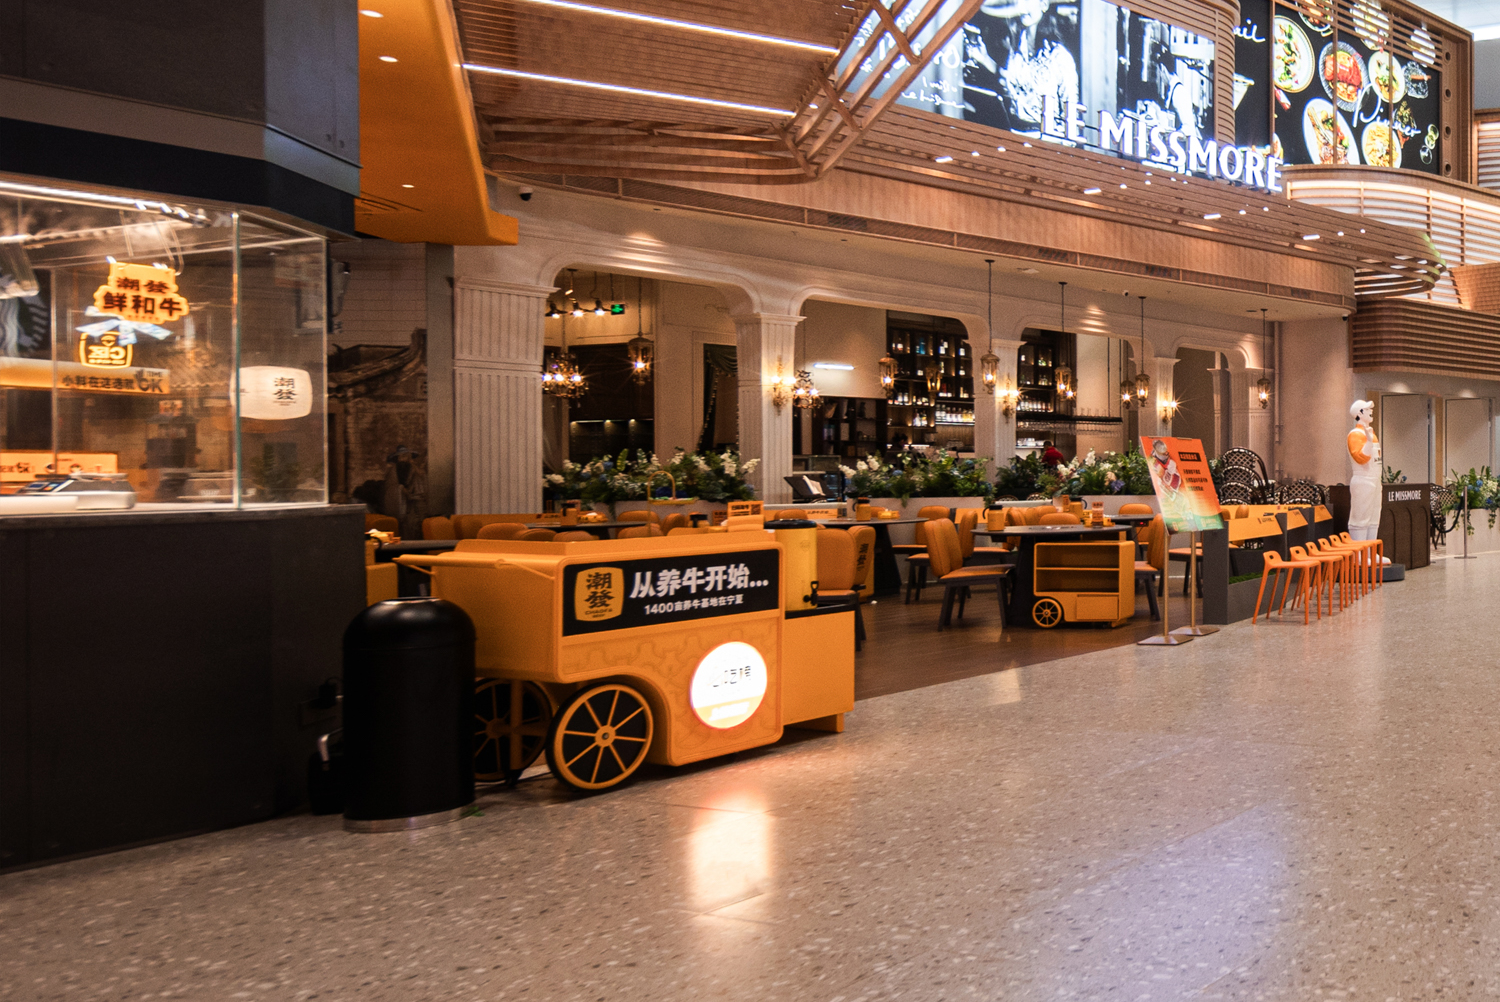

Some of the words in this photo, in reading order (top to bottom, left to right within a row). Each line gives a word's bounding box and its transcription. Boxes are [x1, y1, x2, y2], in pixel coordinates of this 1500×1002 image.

[1352, 82, 1421, 138] Dinner
[1041, 96, 1088, 144] LE
[1098, 109, 1283, 193] MISSMORE
[103, 292, 182, 317] 鲜和牛
[1388, 491, 1394, 502] LE
[1395, 490, 1421, 501] MISSMORE
[585, 572, 614, 609] 潮發
